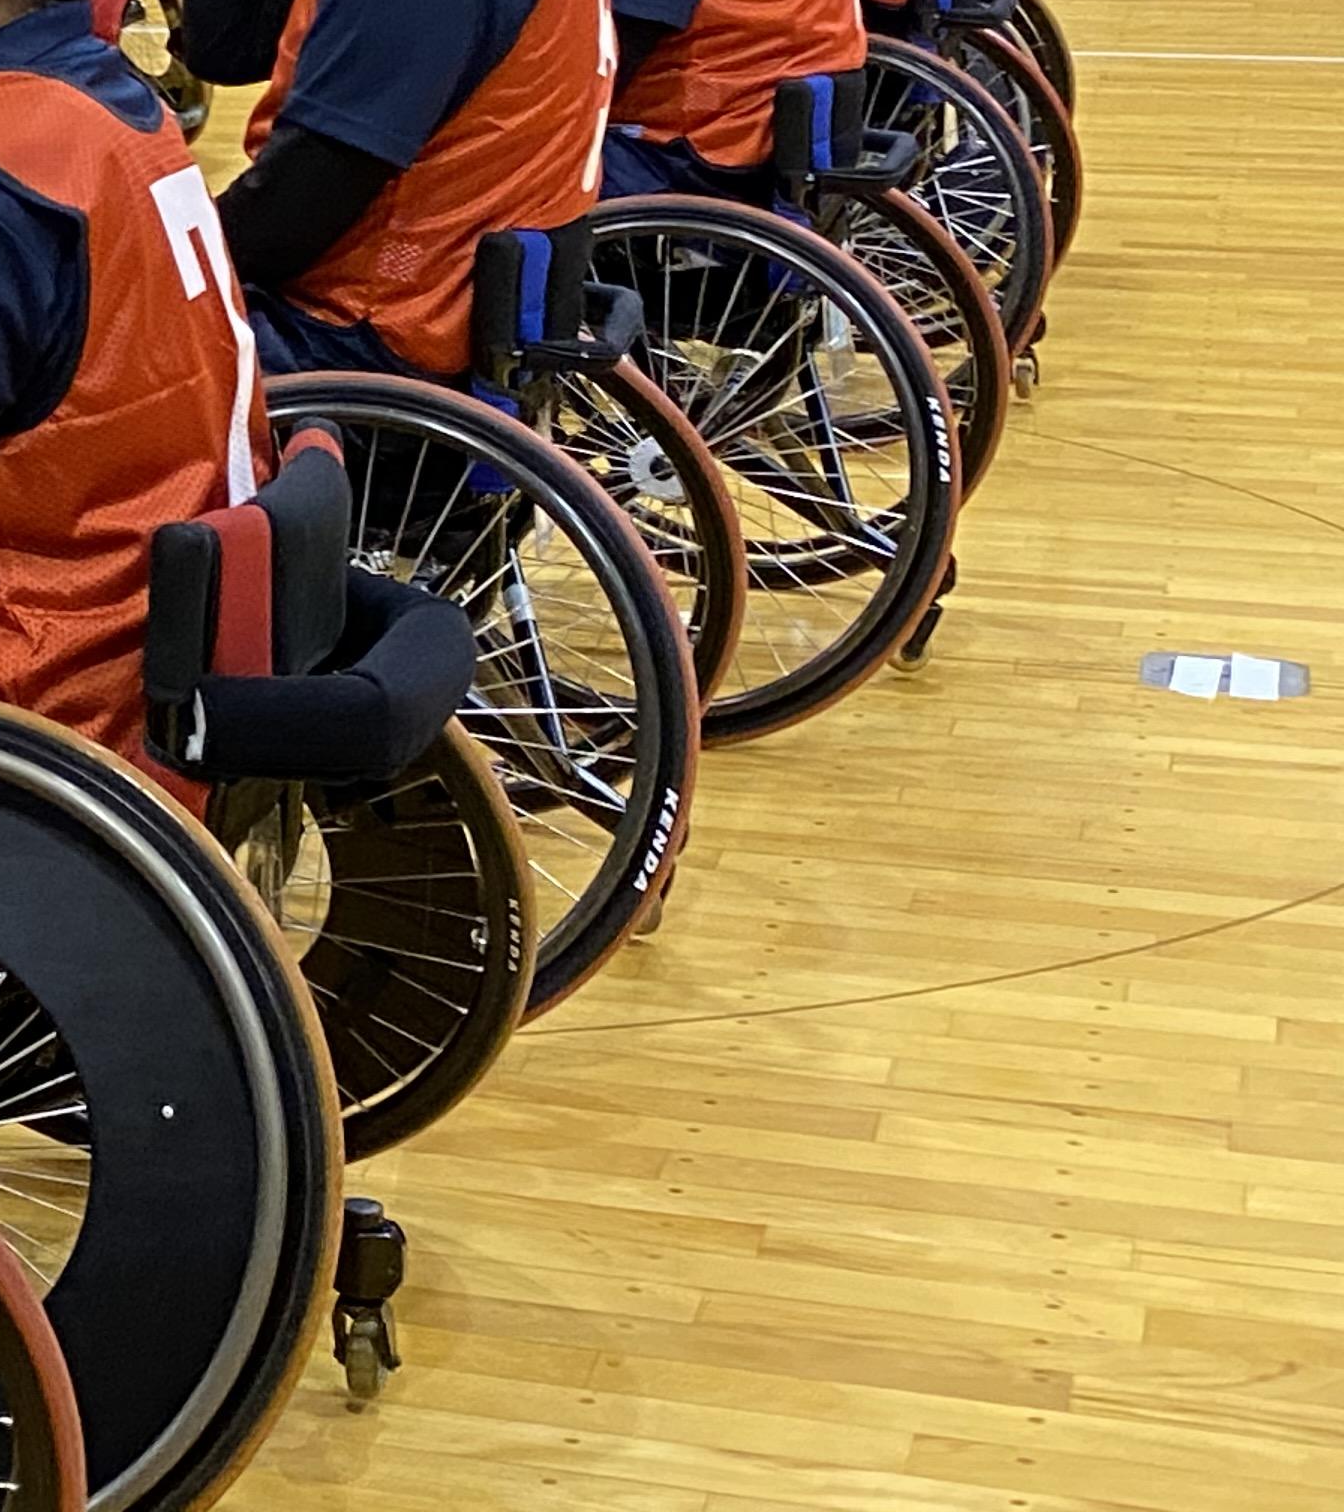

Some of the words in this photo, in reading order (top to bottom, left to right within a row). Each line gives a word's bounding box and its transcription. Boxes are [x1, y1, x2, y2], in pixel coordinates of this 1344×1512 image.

[926, 396, 951, 483] KENDA
[637, 787, 679, 892] KENDA
[508, 898, 521, 973] KENDA
